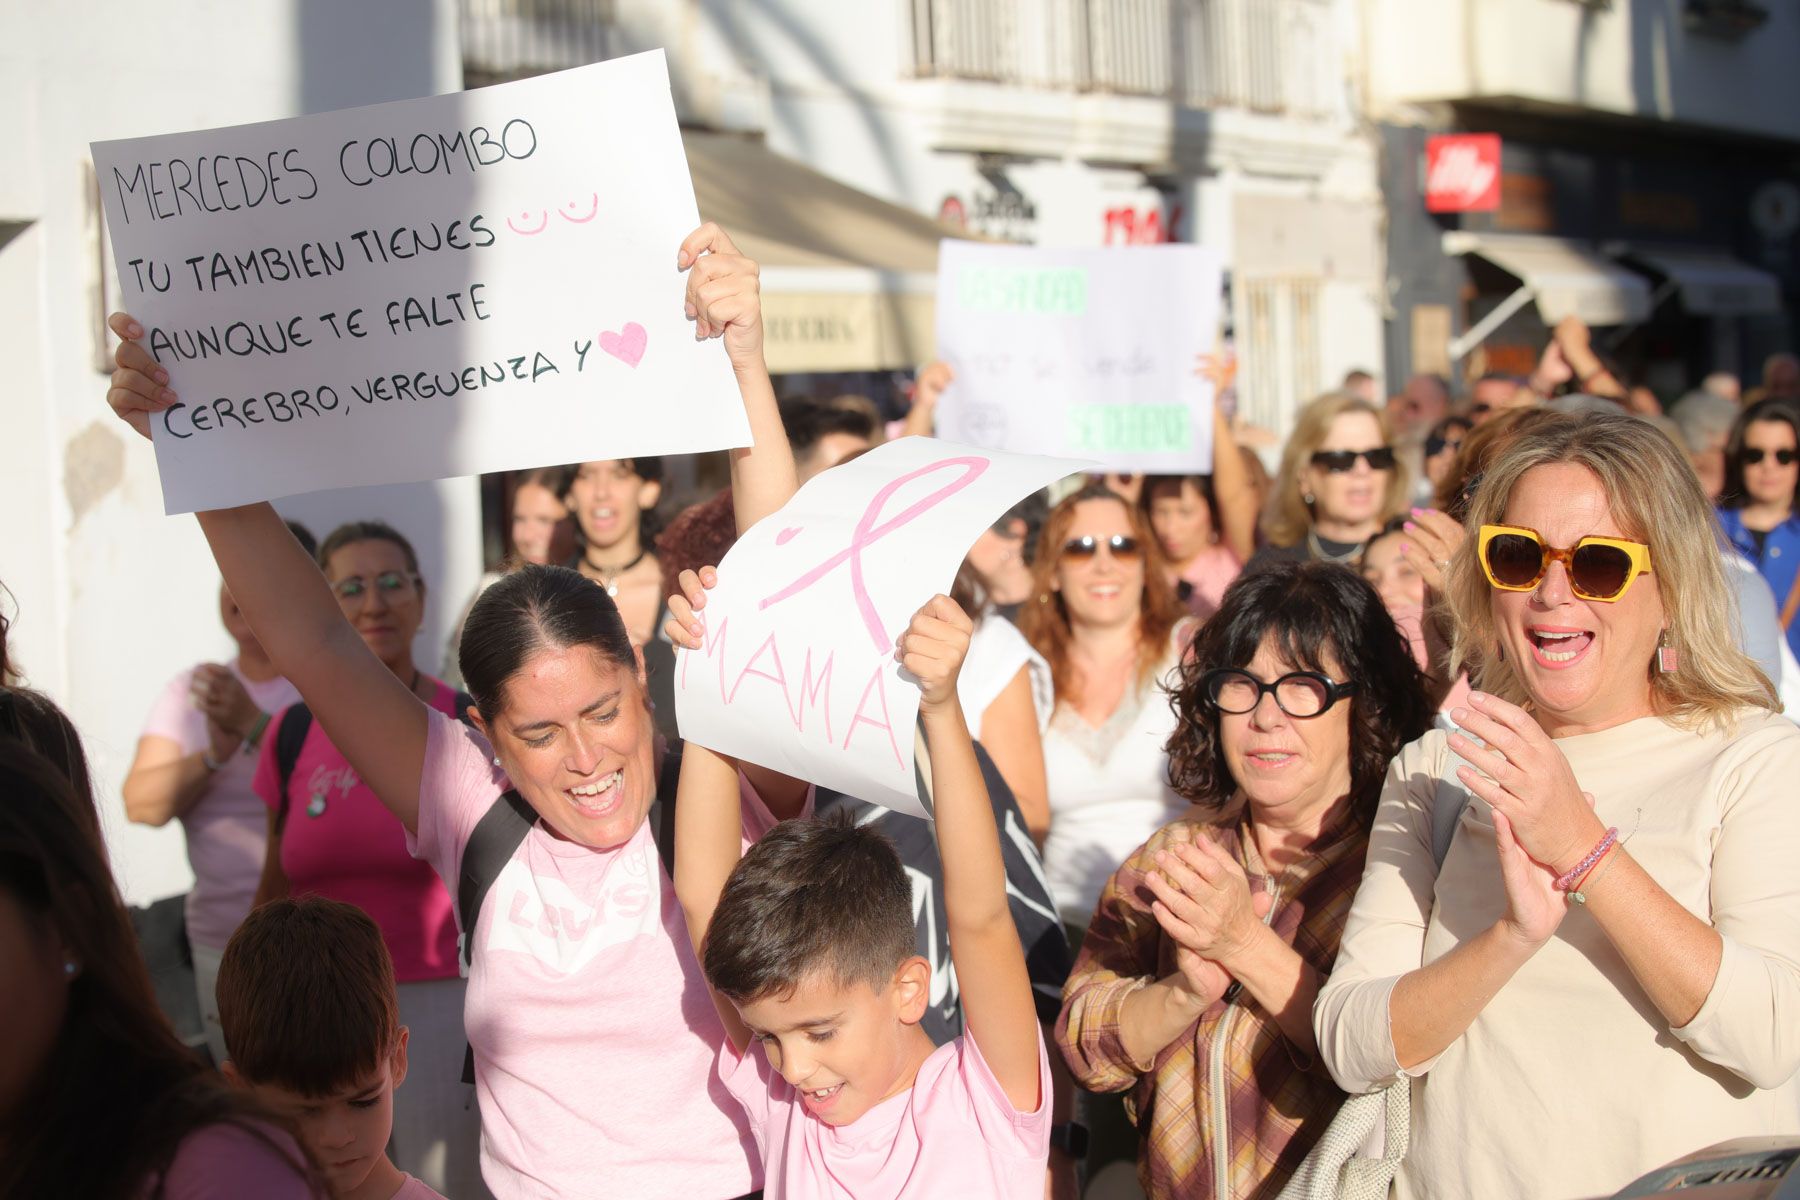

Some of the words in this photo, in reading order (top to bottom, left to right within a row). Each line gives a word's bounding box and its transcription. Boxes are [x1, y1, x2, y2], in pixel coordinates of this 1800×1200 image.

[112, 148, 318, 226] MERCEDES
[339, 118, 538, 187] COLOMBO
[128, 258, 171, 293] TU
[185, 242, 345, 293] TAMBIEN
[350, 214, 496, 264] TIENES
[150, 314, 312, 364] AUNQUE
[318, 308, 368, 341] TE
[386, 283, 491, 336] FALTE
[351, 351, 562, 404] VERGUENZA
[573, 338, 594, 373] Y
